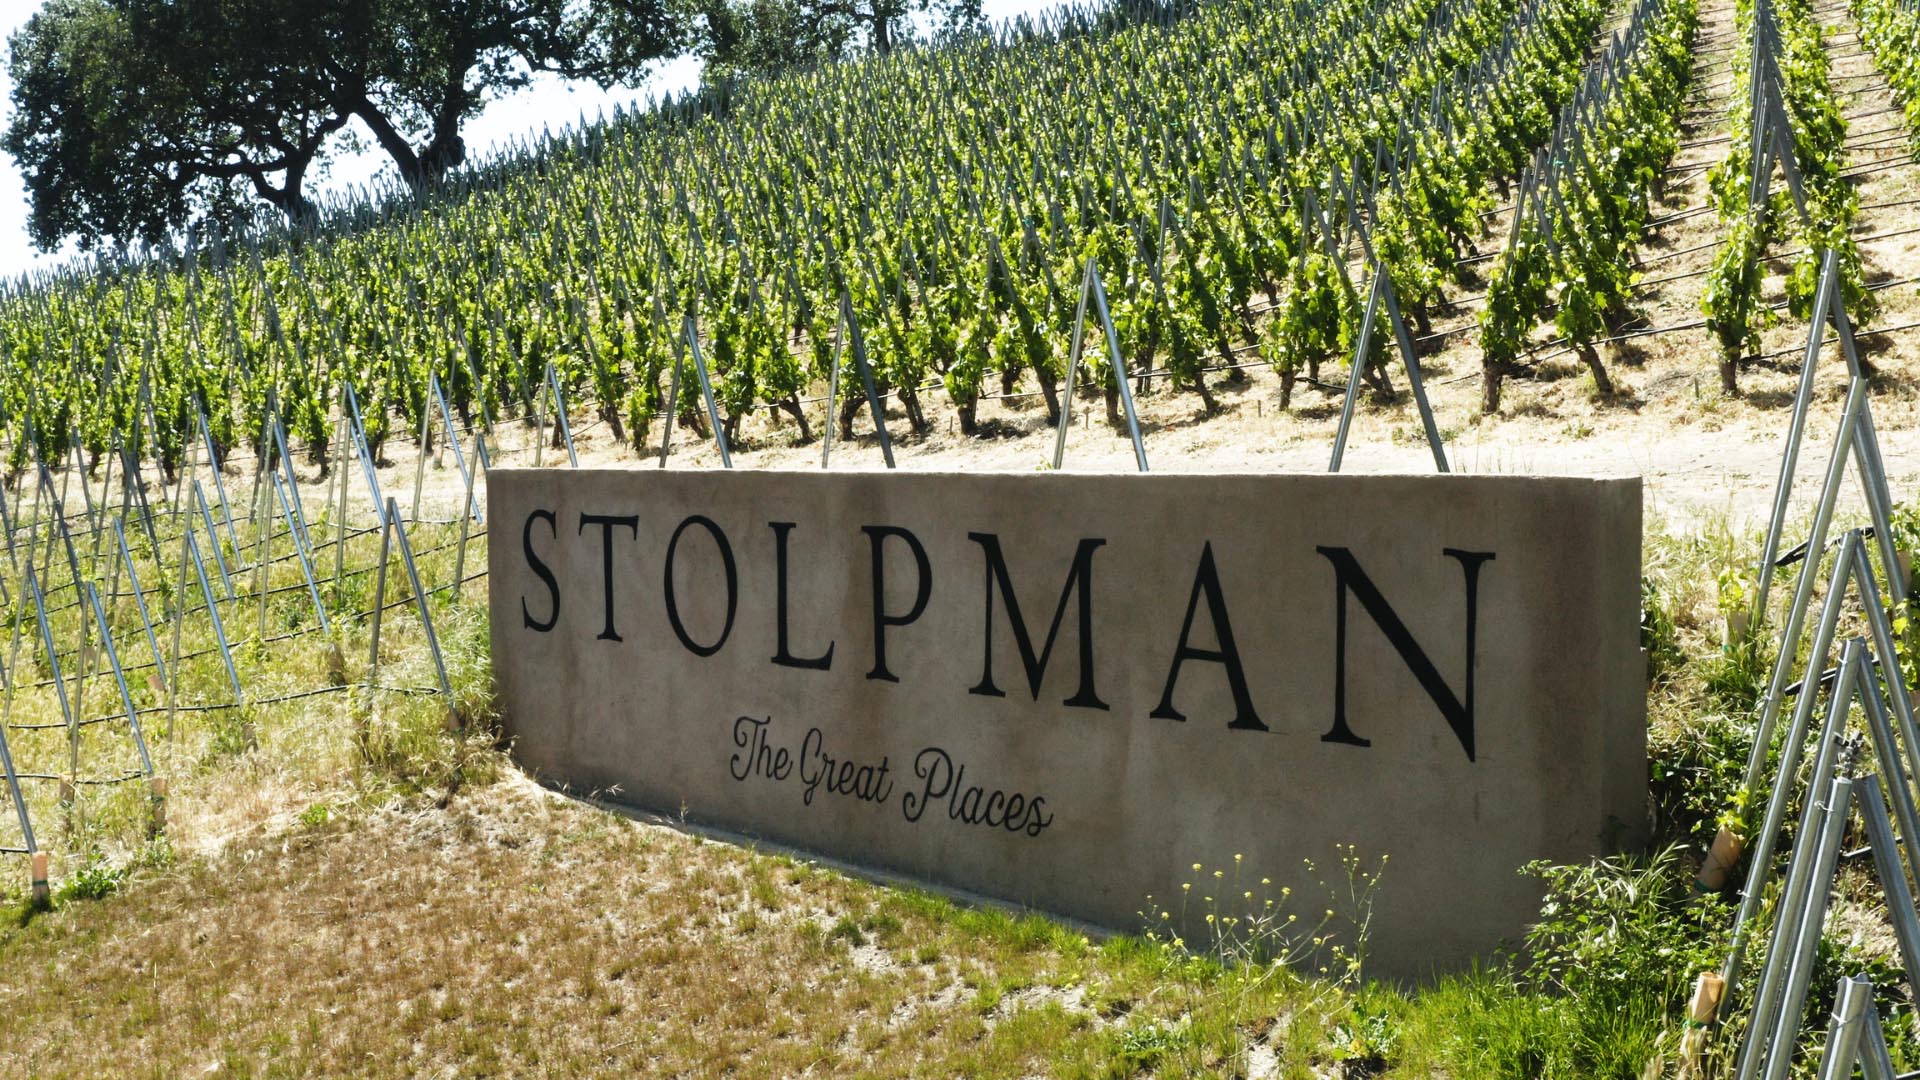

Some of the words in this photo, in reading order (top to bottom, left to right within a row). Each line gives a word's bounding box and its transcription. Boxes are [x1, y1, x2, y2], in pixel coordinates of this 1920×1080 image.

[521, 508, 1497, 763] STOLPMAN
[730, 715, 793, 782] The
[799, 727, 894, 806] Great
[903, 747, 1054, 838] Places
